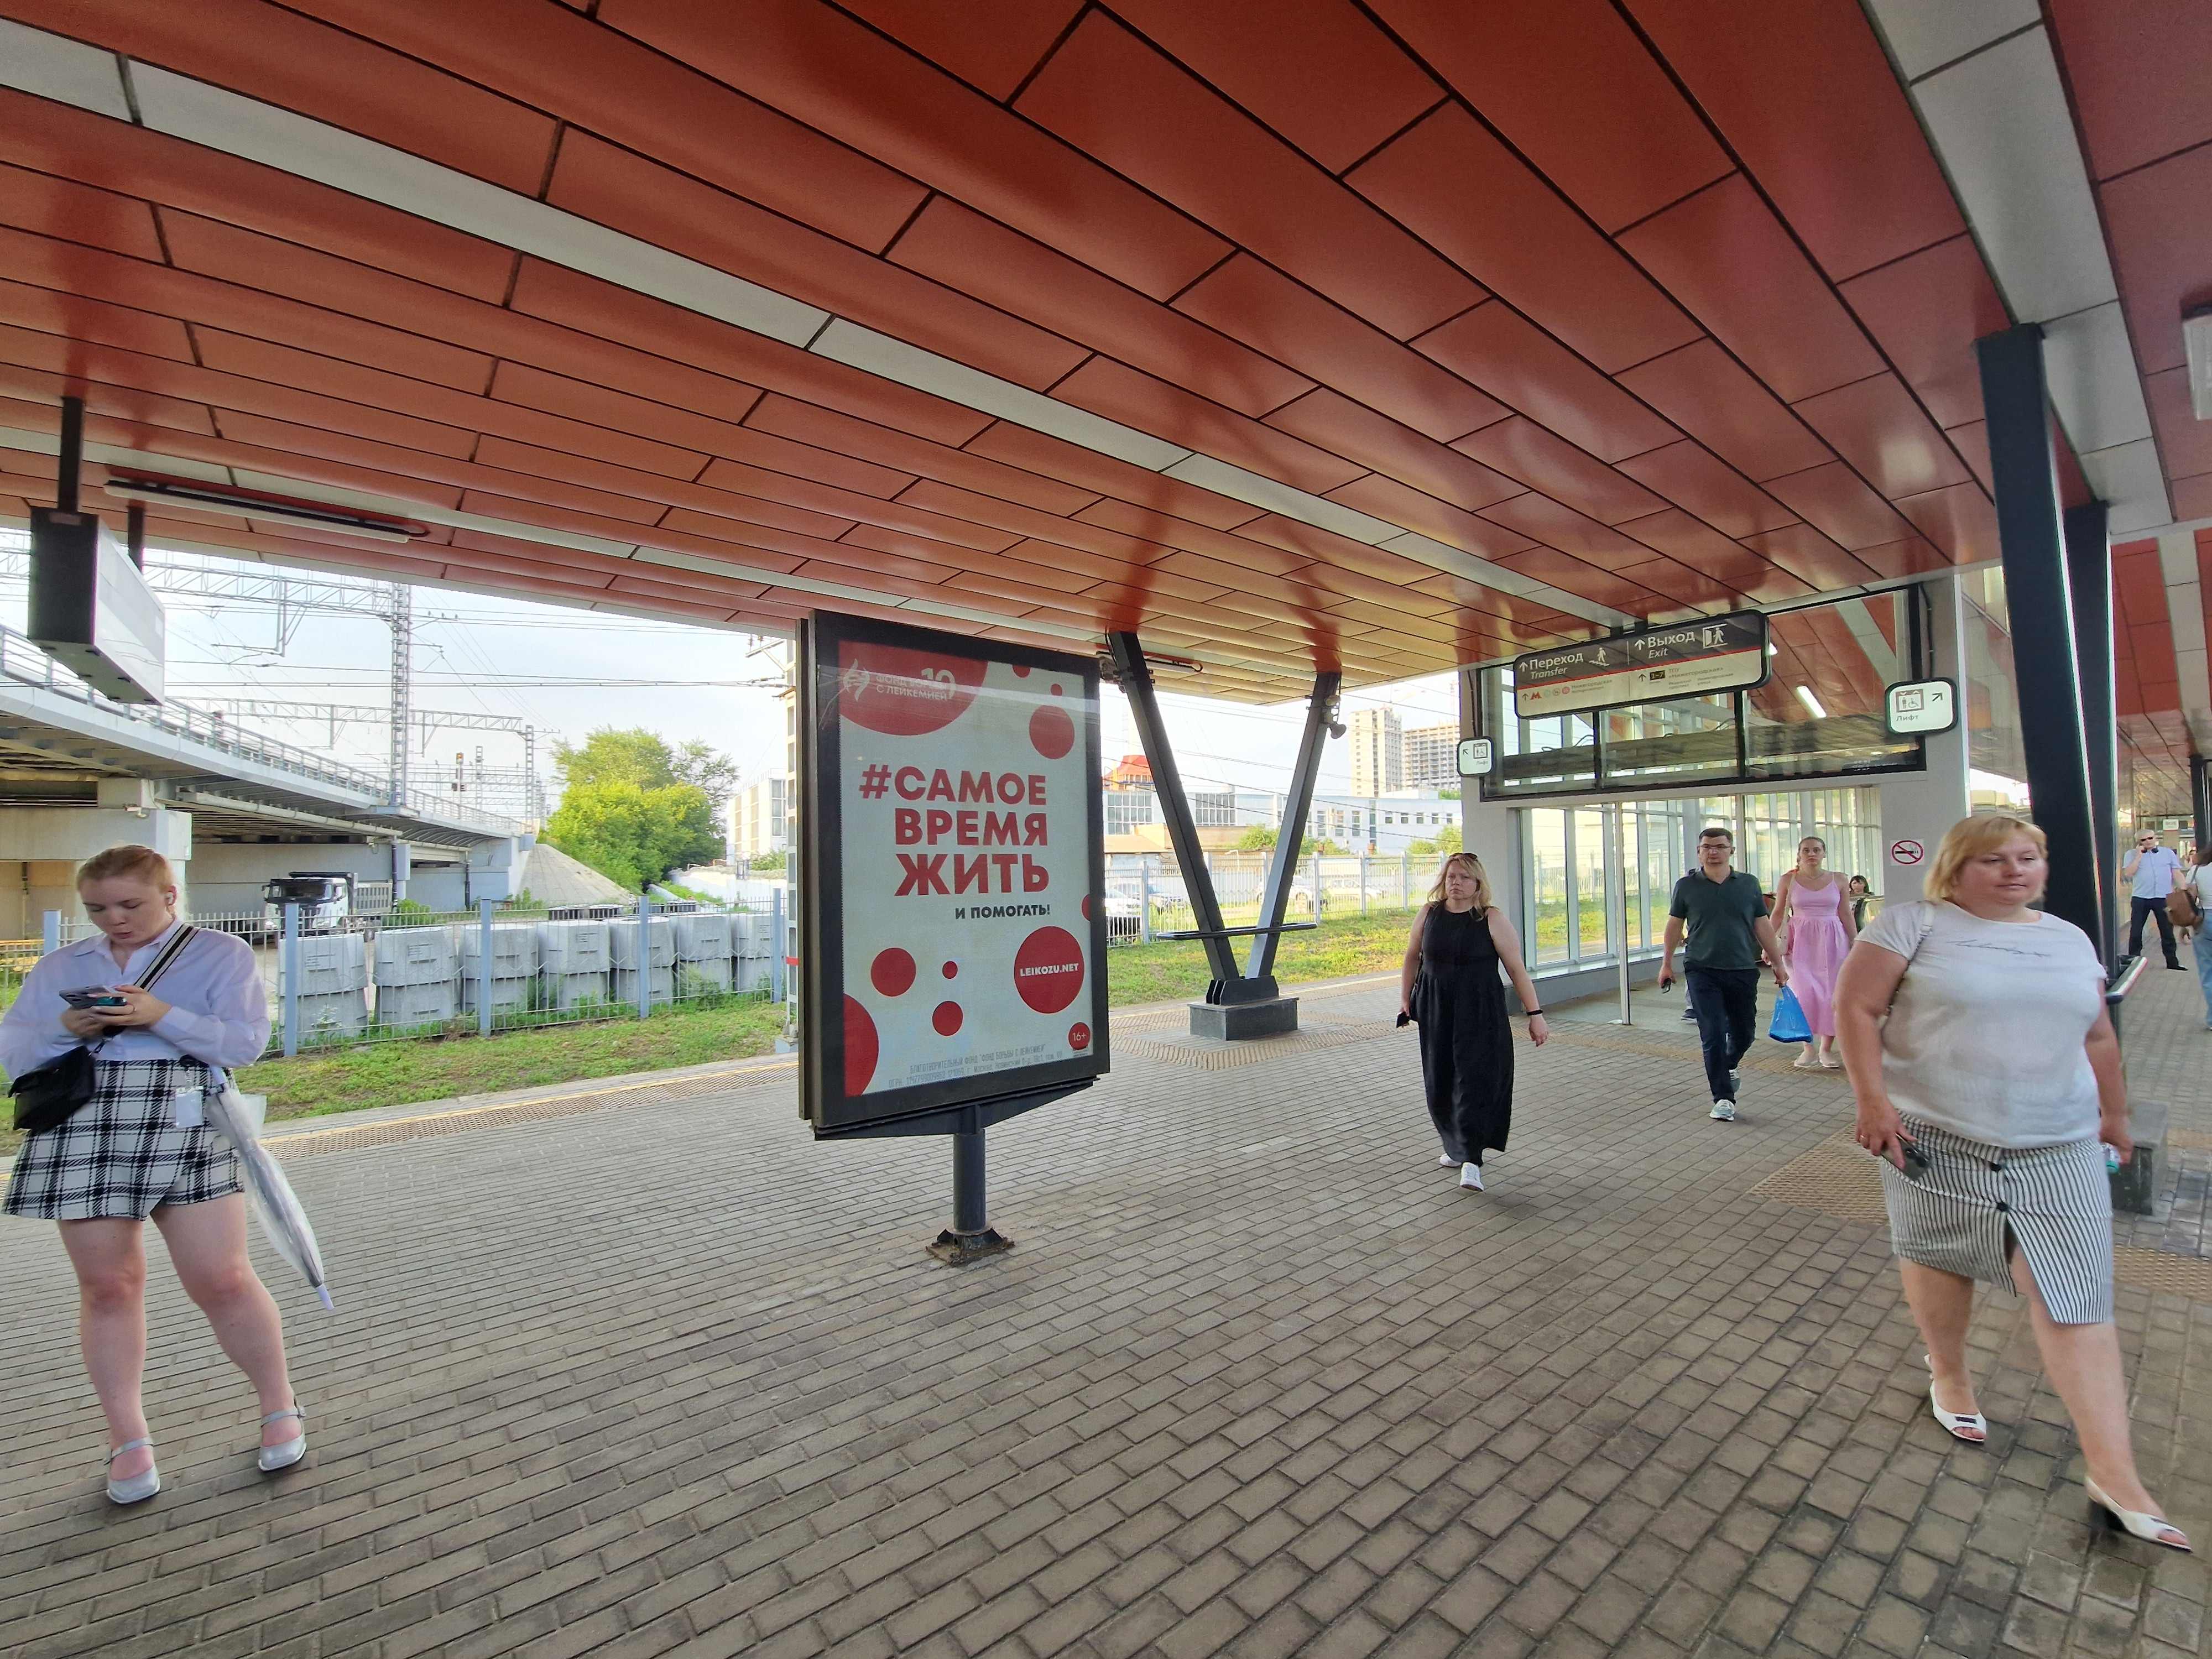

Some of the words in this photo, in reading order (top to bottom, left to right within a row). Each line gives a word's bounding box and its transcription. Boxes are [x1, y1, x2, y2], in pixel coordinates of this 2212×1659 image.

[1647, 631, 1695, 648] Выход
[1529, 653, 1584, 670] Переход
[1648, 648, 1669, 659] Exit
[1530, 666, 1568, 680] Transfer
[858, 763, 1047, 806] #САМОЕ
[894, 807, 1048, 847] ВРЕМЯ
[894, 853, 1050, 897] ЖИТЬ
[955, 907, 966, 920] И
[971, 904, 1051, 919] ПОМОГАТЬ!
[1019, 963, 1079, 977] LEIKOZU.NET
[1072, 1031, 1087, 1042] 16+
